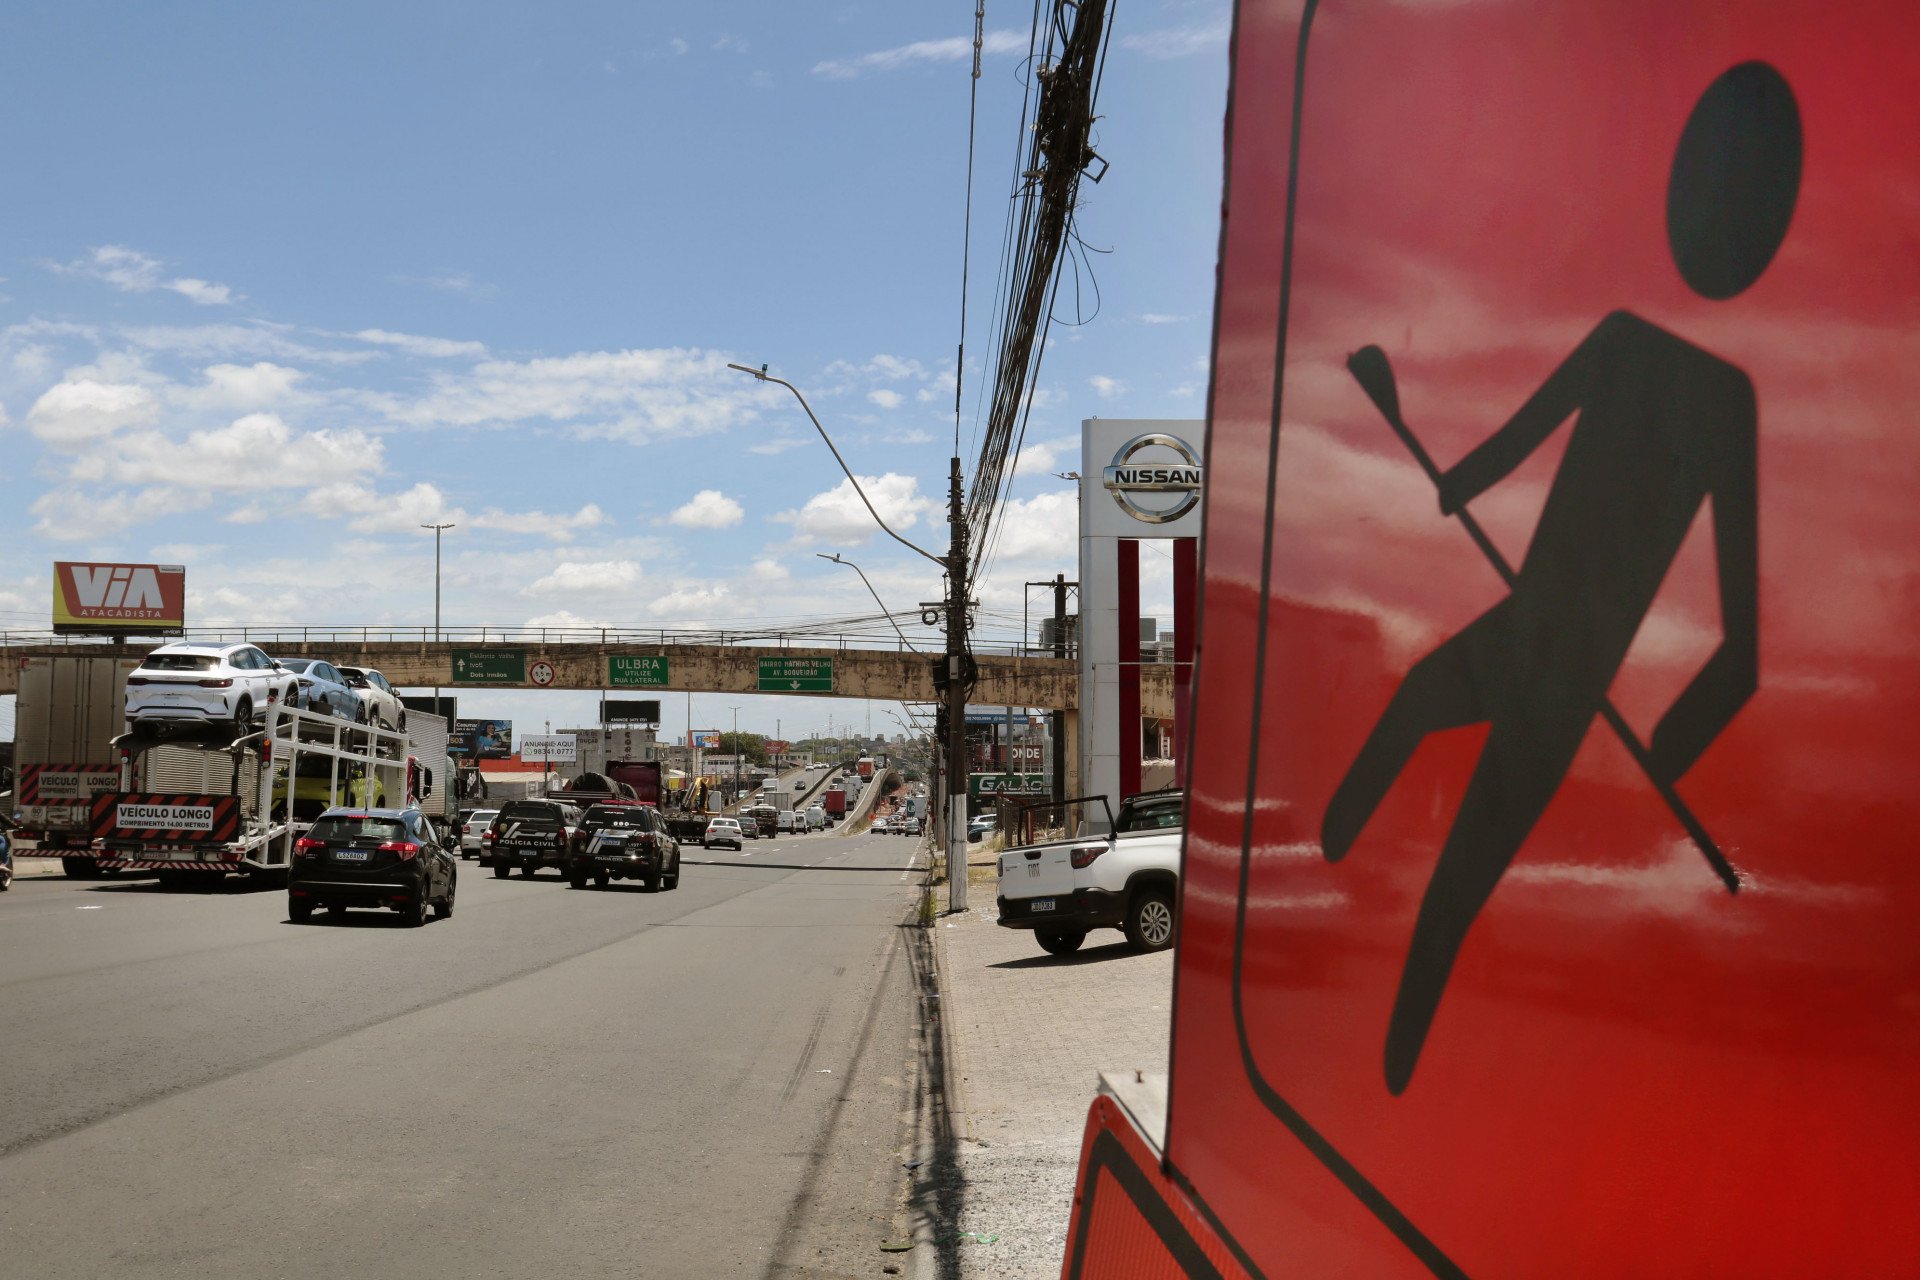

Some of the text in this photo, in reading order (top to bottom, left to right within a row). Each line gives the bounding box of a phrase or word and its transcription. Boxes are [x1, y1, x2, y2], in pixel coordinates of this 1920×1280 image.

[1115, 469, 1200, 484] NISSAN
[80, 608, 161, 618] ATACADISTA
[616, 659, 660, 669] ULBRA
[783, 667, 818, 676] BOQUEIRÃO
[41, 775, 117, 786] VEÍCULO LONGO
[120, 806, 212, 820] VEÍCULO LONGO
[499, 839, 532, 847] POLÍCIA
